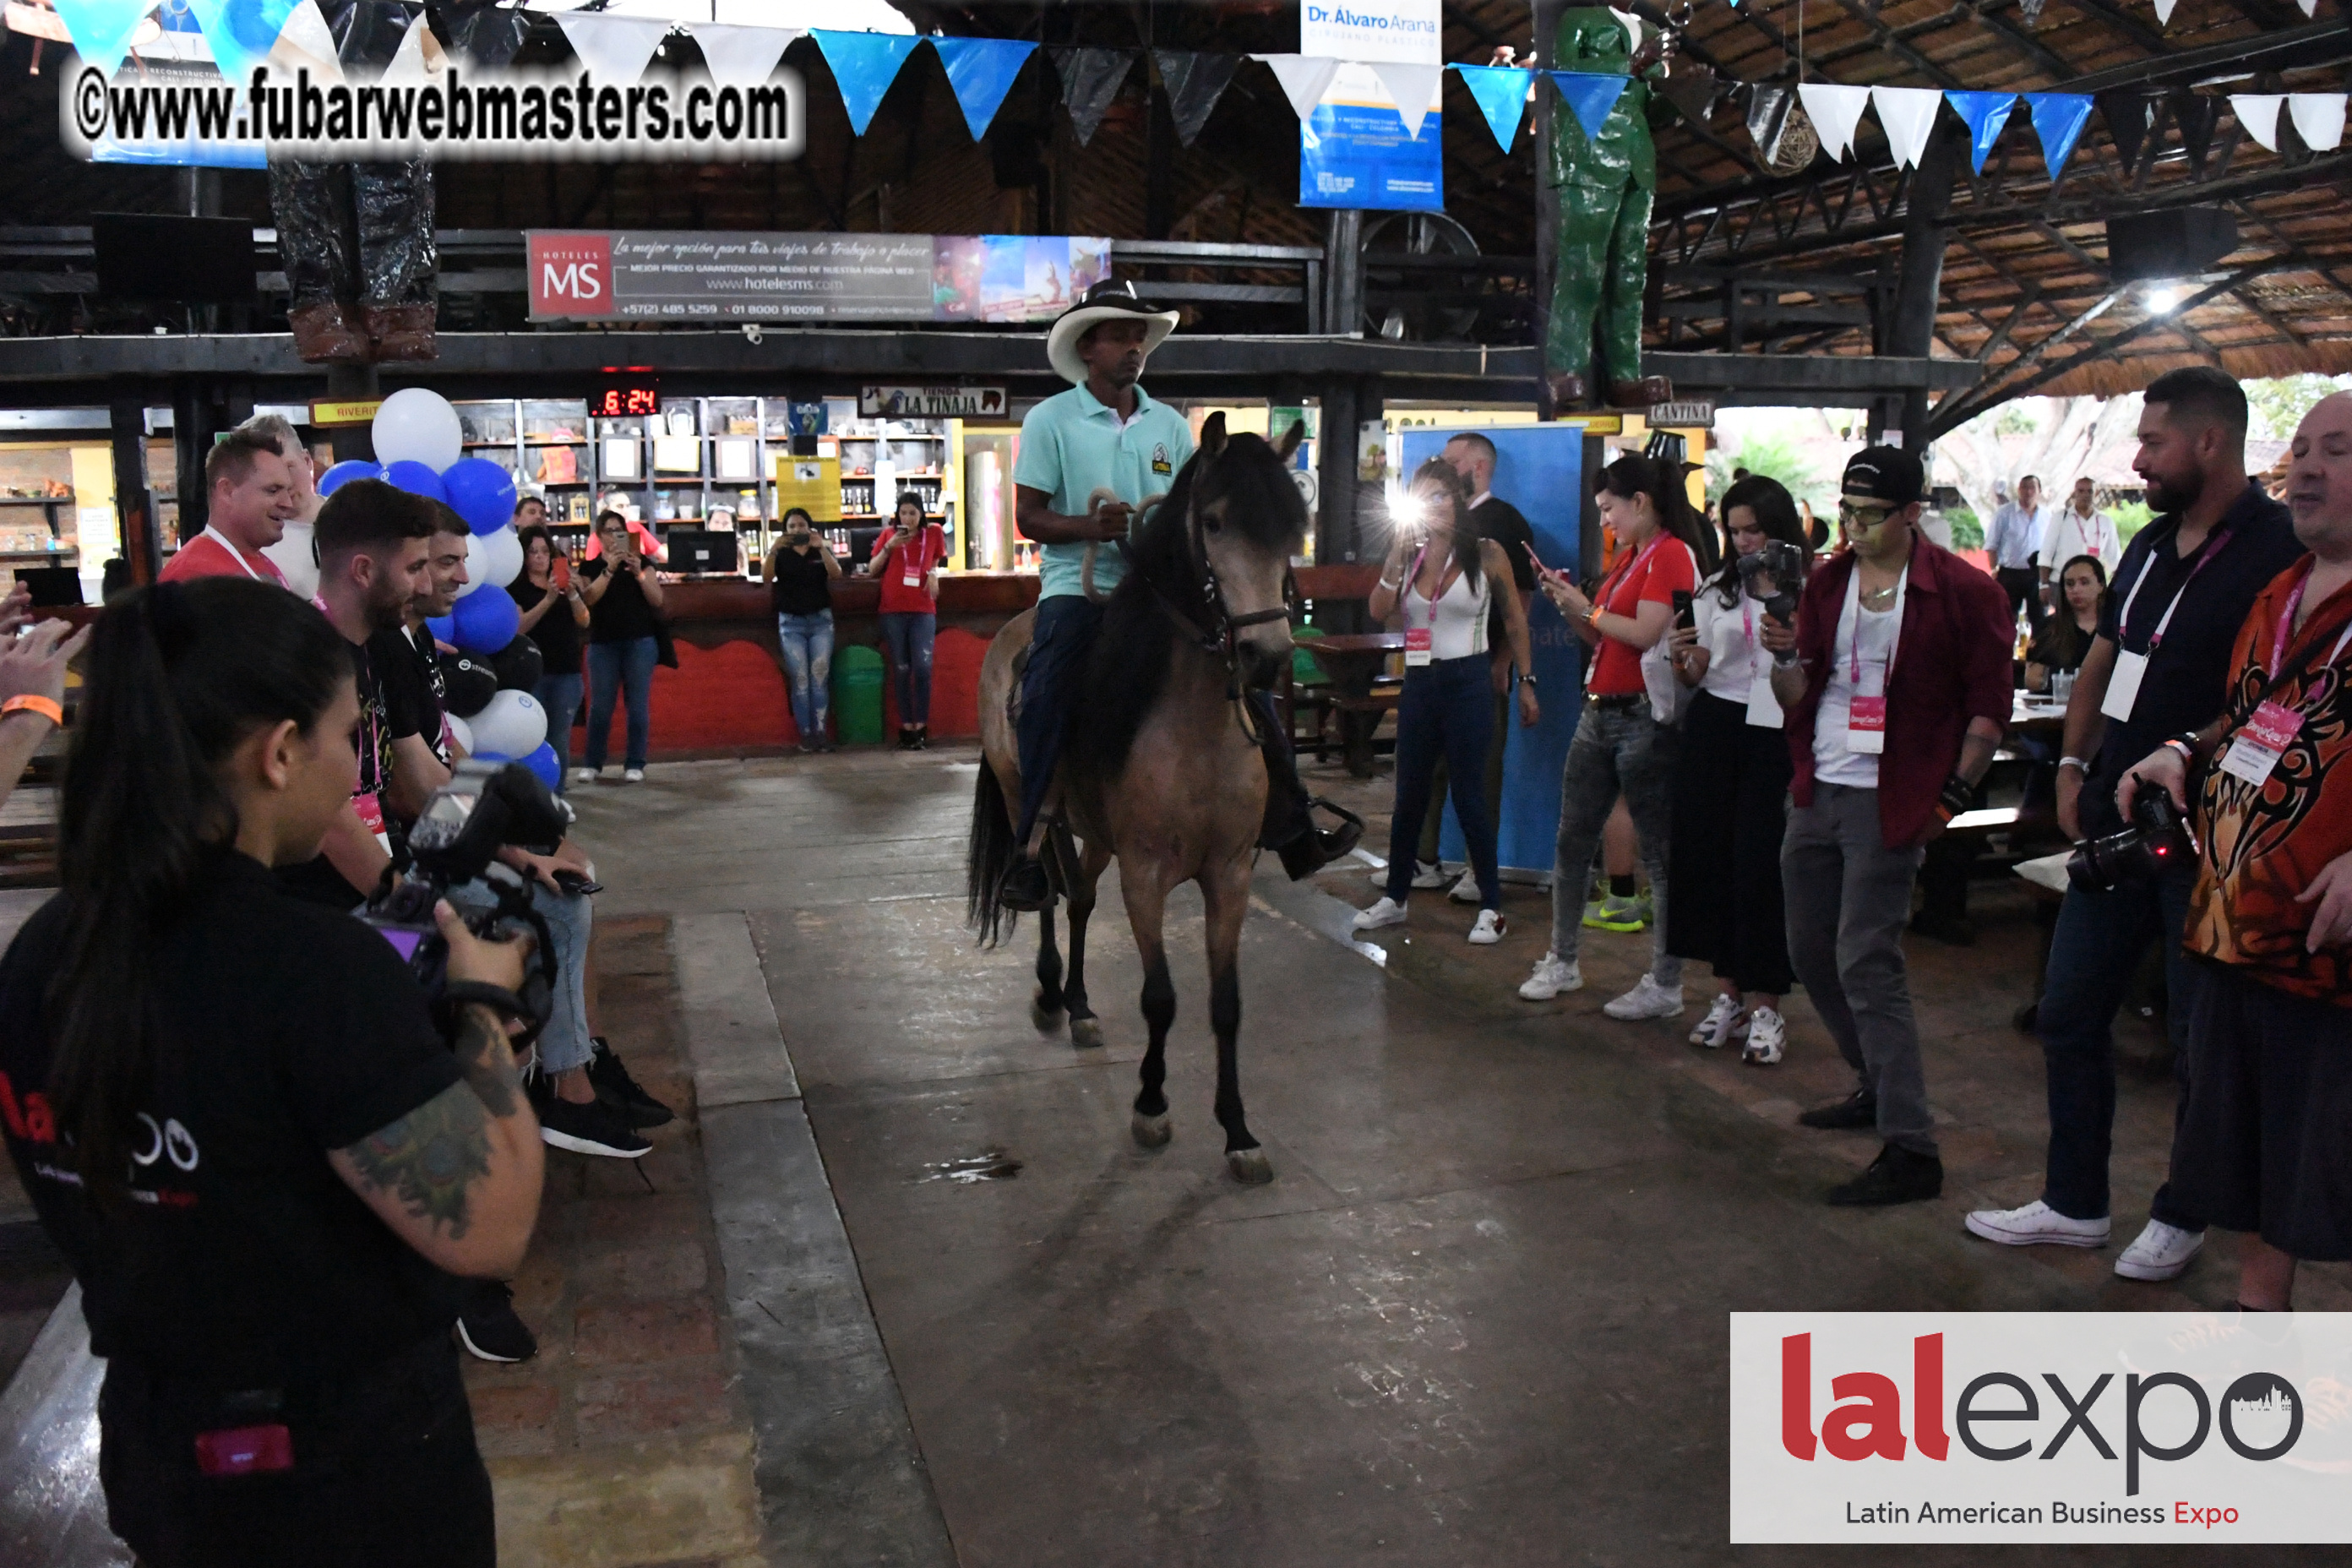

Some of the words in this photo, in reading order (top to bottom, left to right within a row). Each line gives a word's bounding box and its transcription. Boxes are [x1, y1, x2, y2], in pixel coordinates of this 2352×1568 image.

[1308, 6, 1332, 23] Dr.
[1335, 5, 1388, 29] Álvaro
[1390, 15, 1435, 33] Arana
[542, 251, 599, 259] HOTELES
[613, 237, 629, 255] La
[632, 241, 670, 259] mejor
[713, 242, 746, 259] para
[773, 242, 808, 260] viajes
[811, 242, 828, 255] de
[886, 242, 930, 262] placer
[630, 264, 660, 272] MEJOR
[662, 264, 694, 272] PRECIO
[695, 264, 757, 273] GARANTIZADO
[760, 264, 777, 273] POR
[780, 265, 808, 274] MEDIO
[823, 266, 862, 275] NUESTRA
[543, 263, 601, 298] MS
[706, 276, 843, 291] www.hotelesms.com
[622, 304, 659, 314] +57(2)
[688, 304, 718, 314] 5259
[732, 305, 745, 314] 01
[748, 305, 779, 314] 8000
[782, 305, 824, 315] 910098
[922, 387, 961, 395] TIENDA
[605, 389, 655, 411] 6:24
[906, 396, 922, 413] LA
[926, 396, 977, 414] TINAJA
[337, 406, 378, 416] RIVERIT
[1651, 402, 1712, 422] CANTINA
